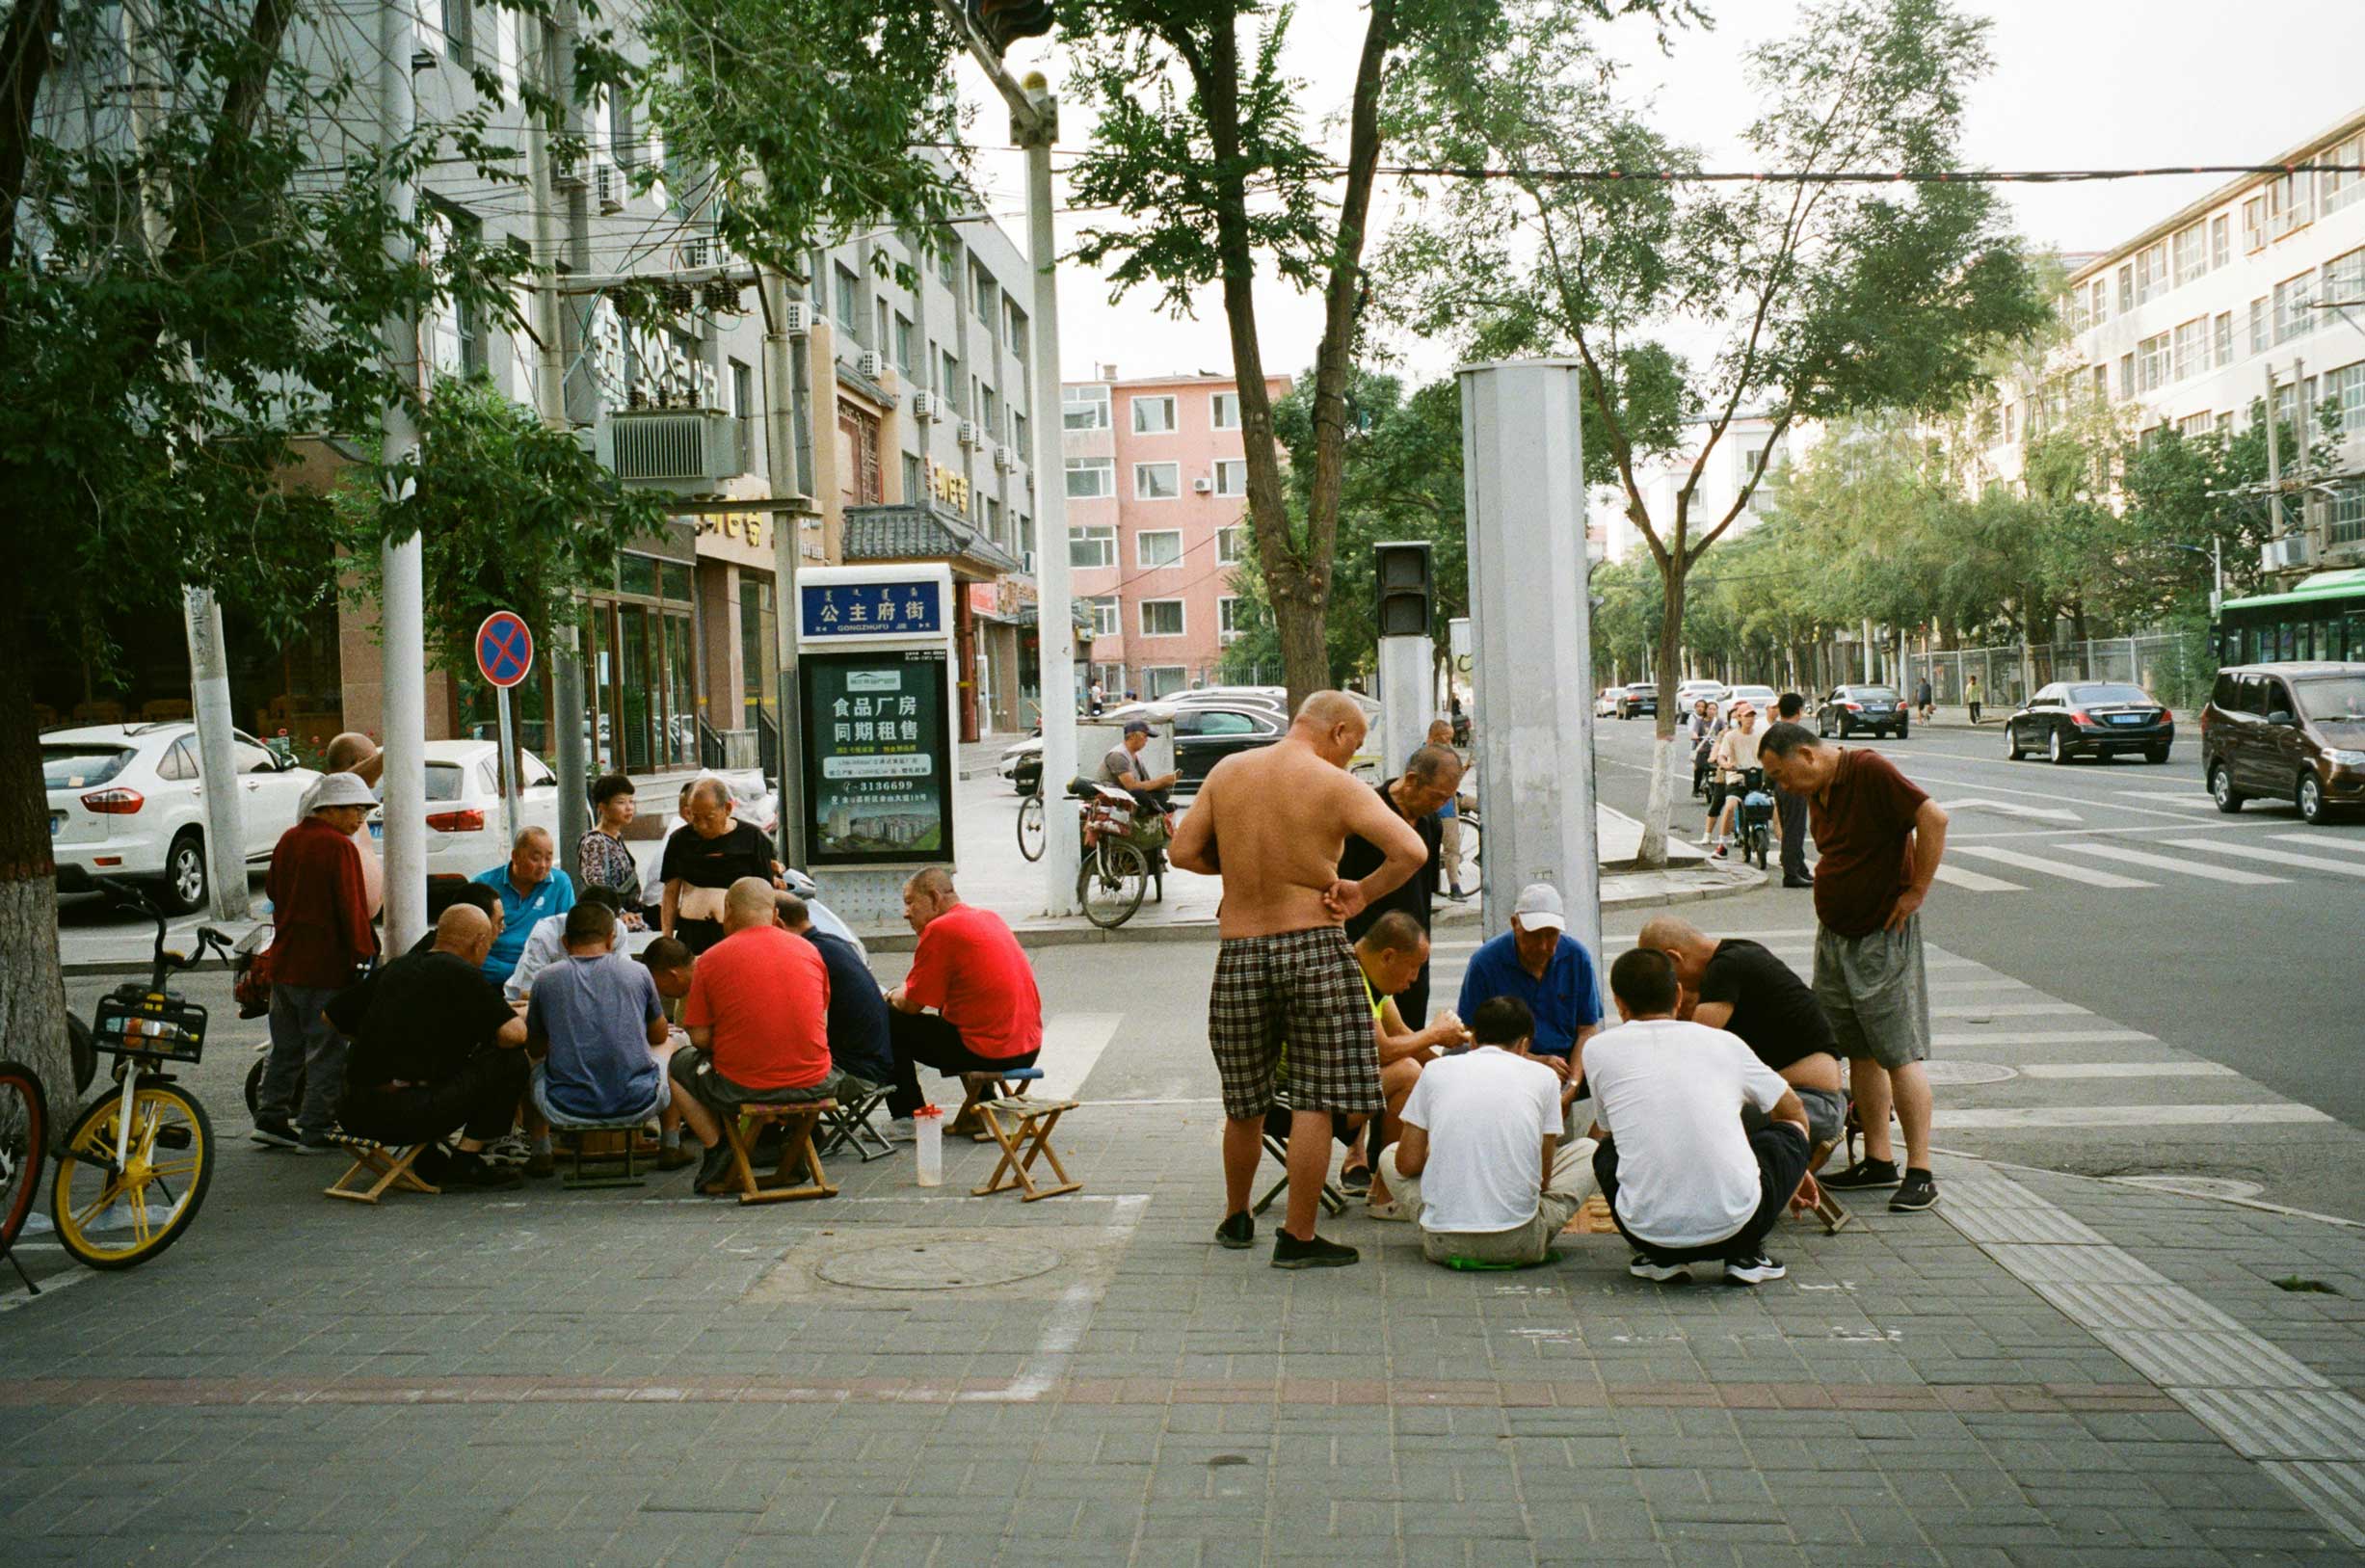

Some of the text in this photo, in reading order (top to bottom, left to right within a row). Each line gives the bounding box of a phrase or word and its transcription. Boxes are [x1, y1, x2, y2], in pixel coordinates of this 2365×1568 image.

[820, 600, 924, 623] 公主府街
[837, 624, 890, 632] GONGZHUFU
[833, 696, 917, 717] 食品厂房
[834, 720, 917, 742] 同期租售
[860, 781, 913, 791] 3136699
